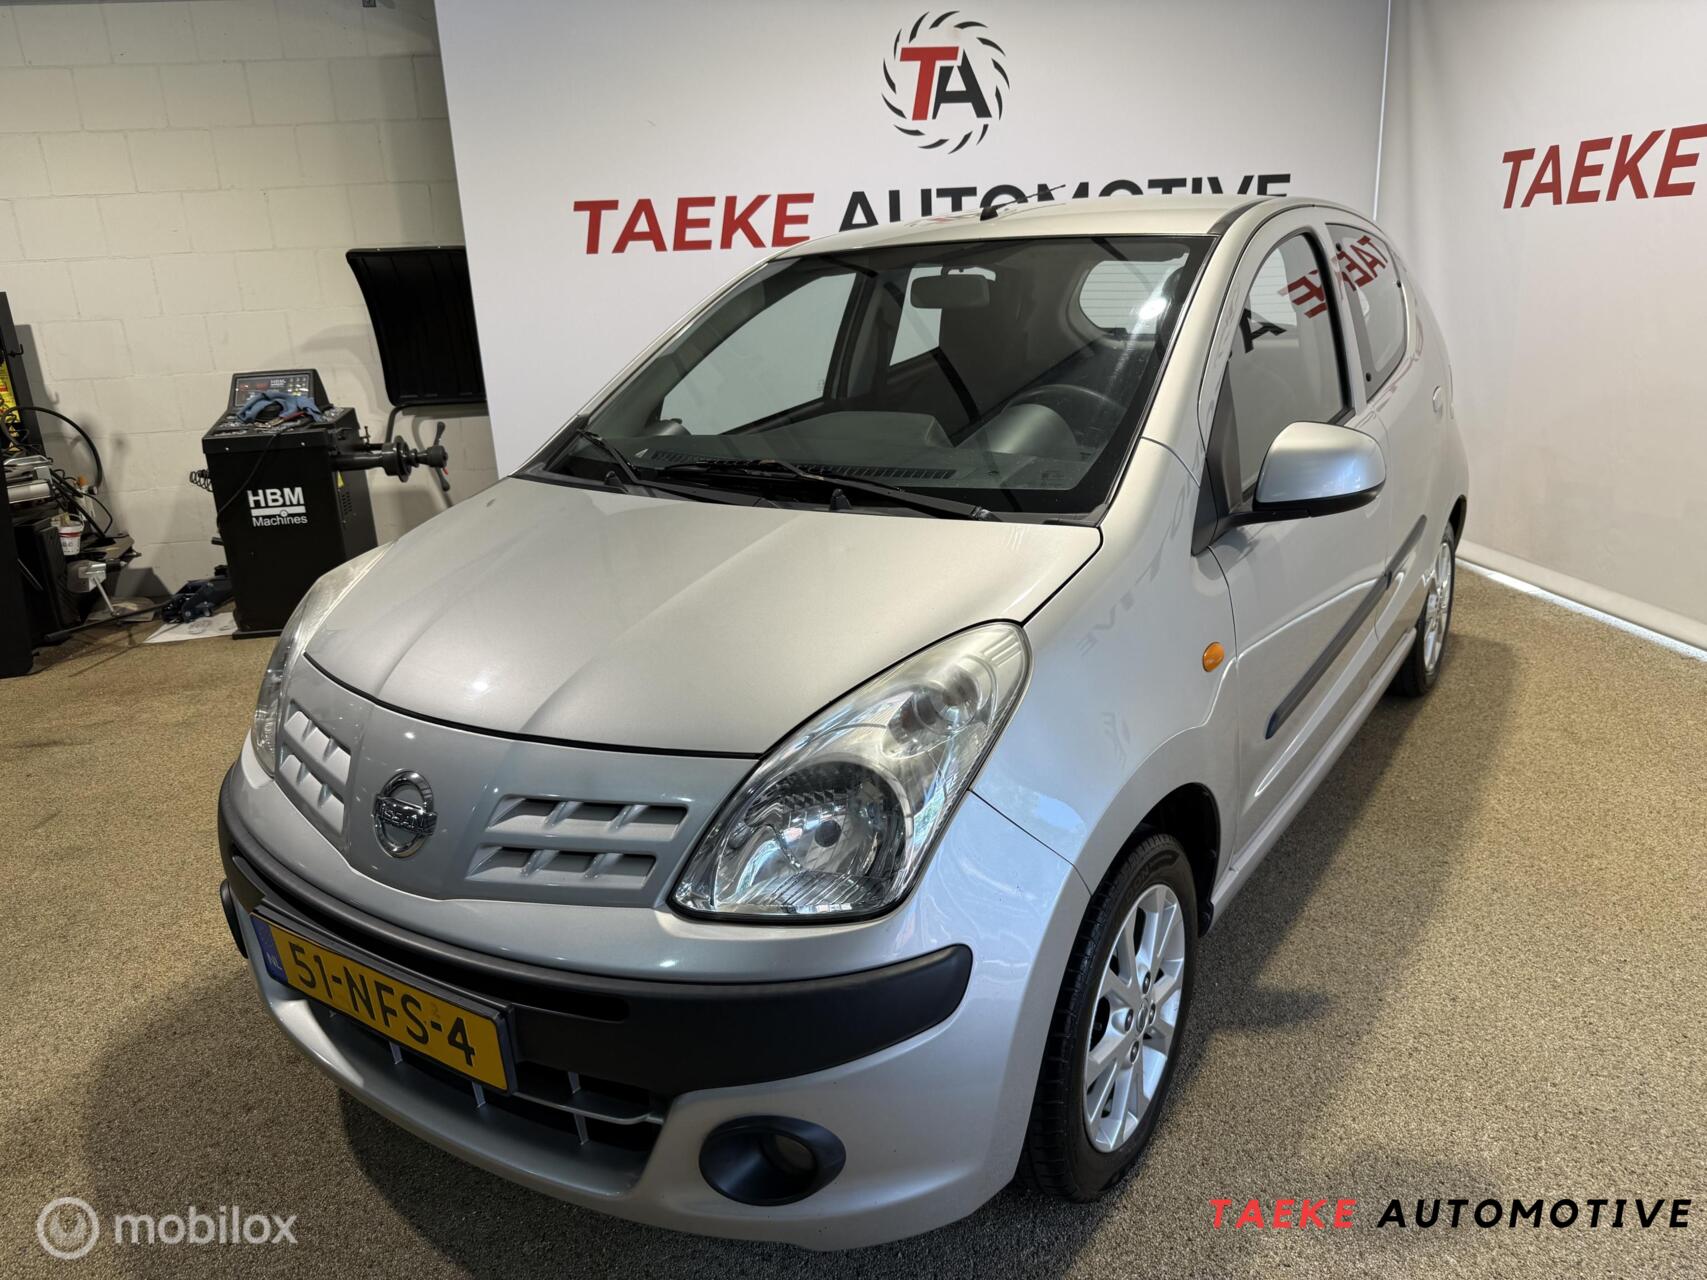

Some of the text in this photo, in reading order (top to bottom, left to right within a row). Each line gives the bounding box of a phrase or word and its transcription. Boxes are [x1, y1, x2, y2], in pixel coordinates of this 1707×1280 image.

[900, 46, 992, 121] TA
[1503, 123, 1707, 209] TAEKE
[573, 193, 815, 255] TAEKE
[247, 486, 305, 508] HBM
[252, 515, 308, 527] Machines
[266, 951, 283, 971] NL
[288, 941, 476, 1067] 51-NFS-4
